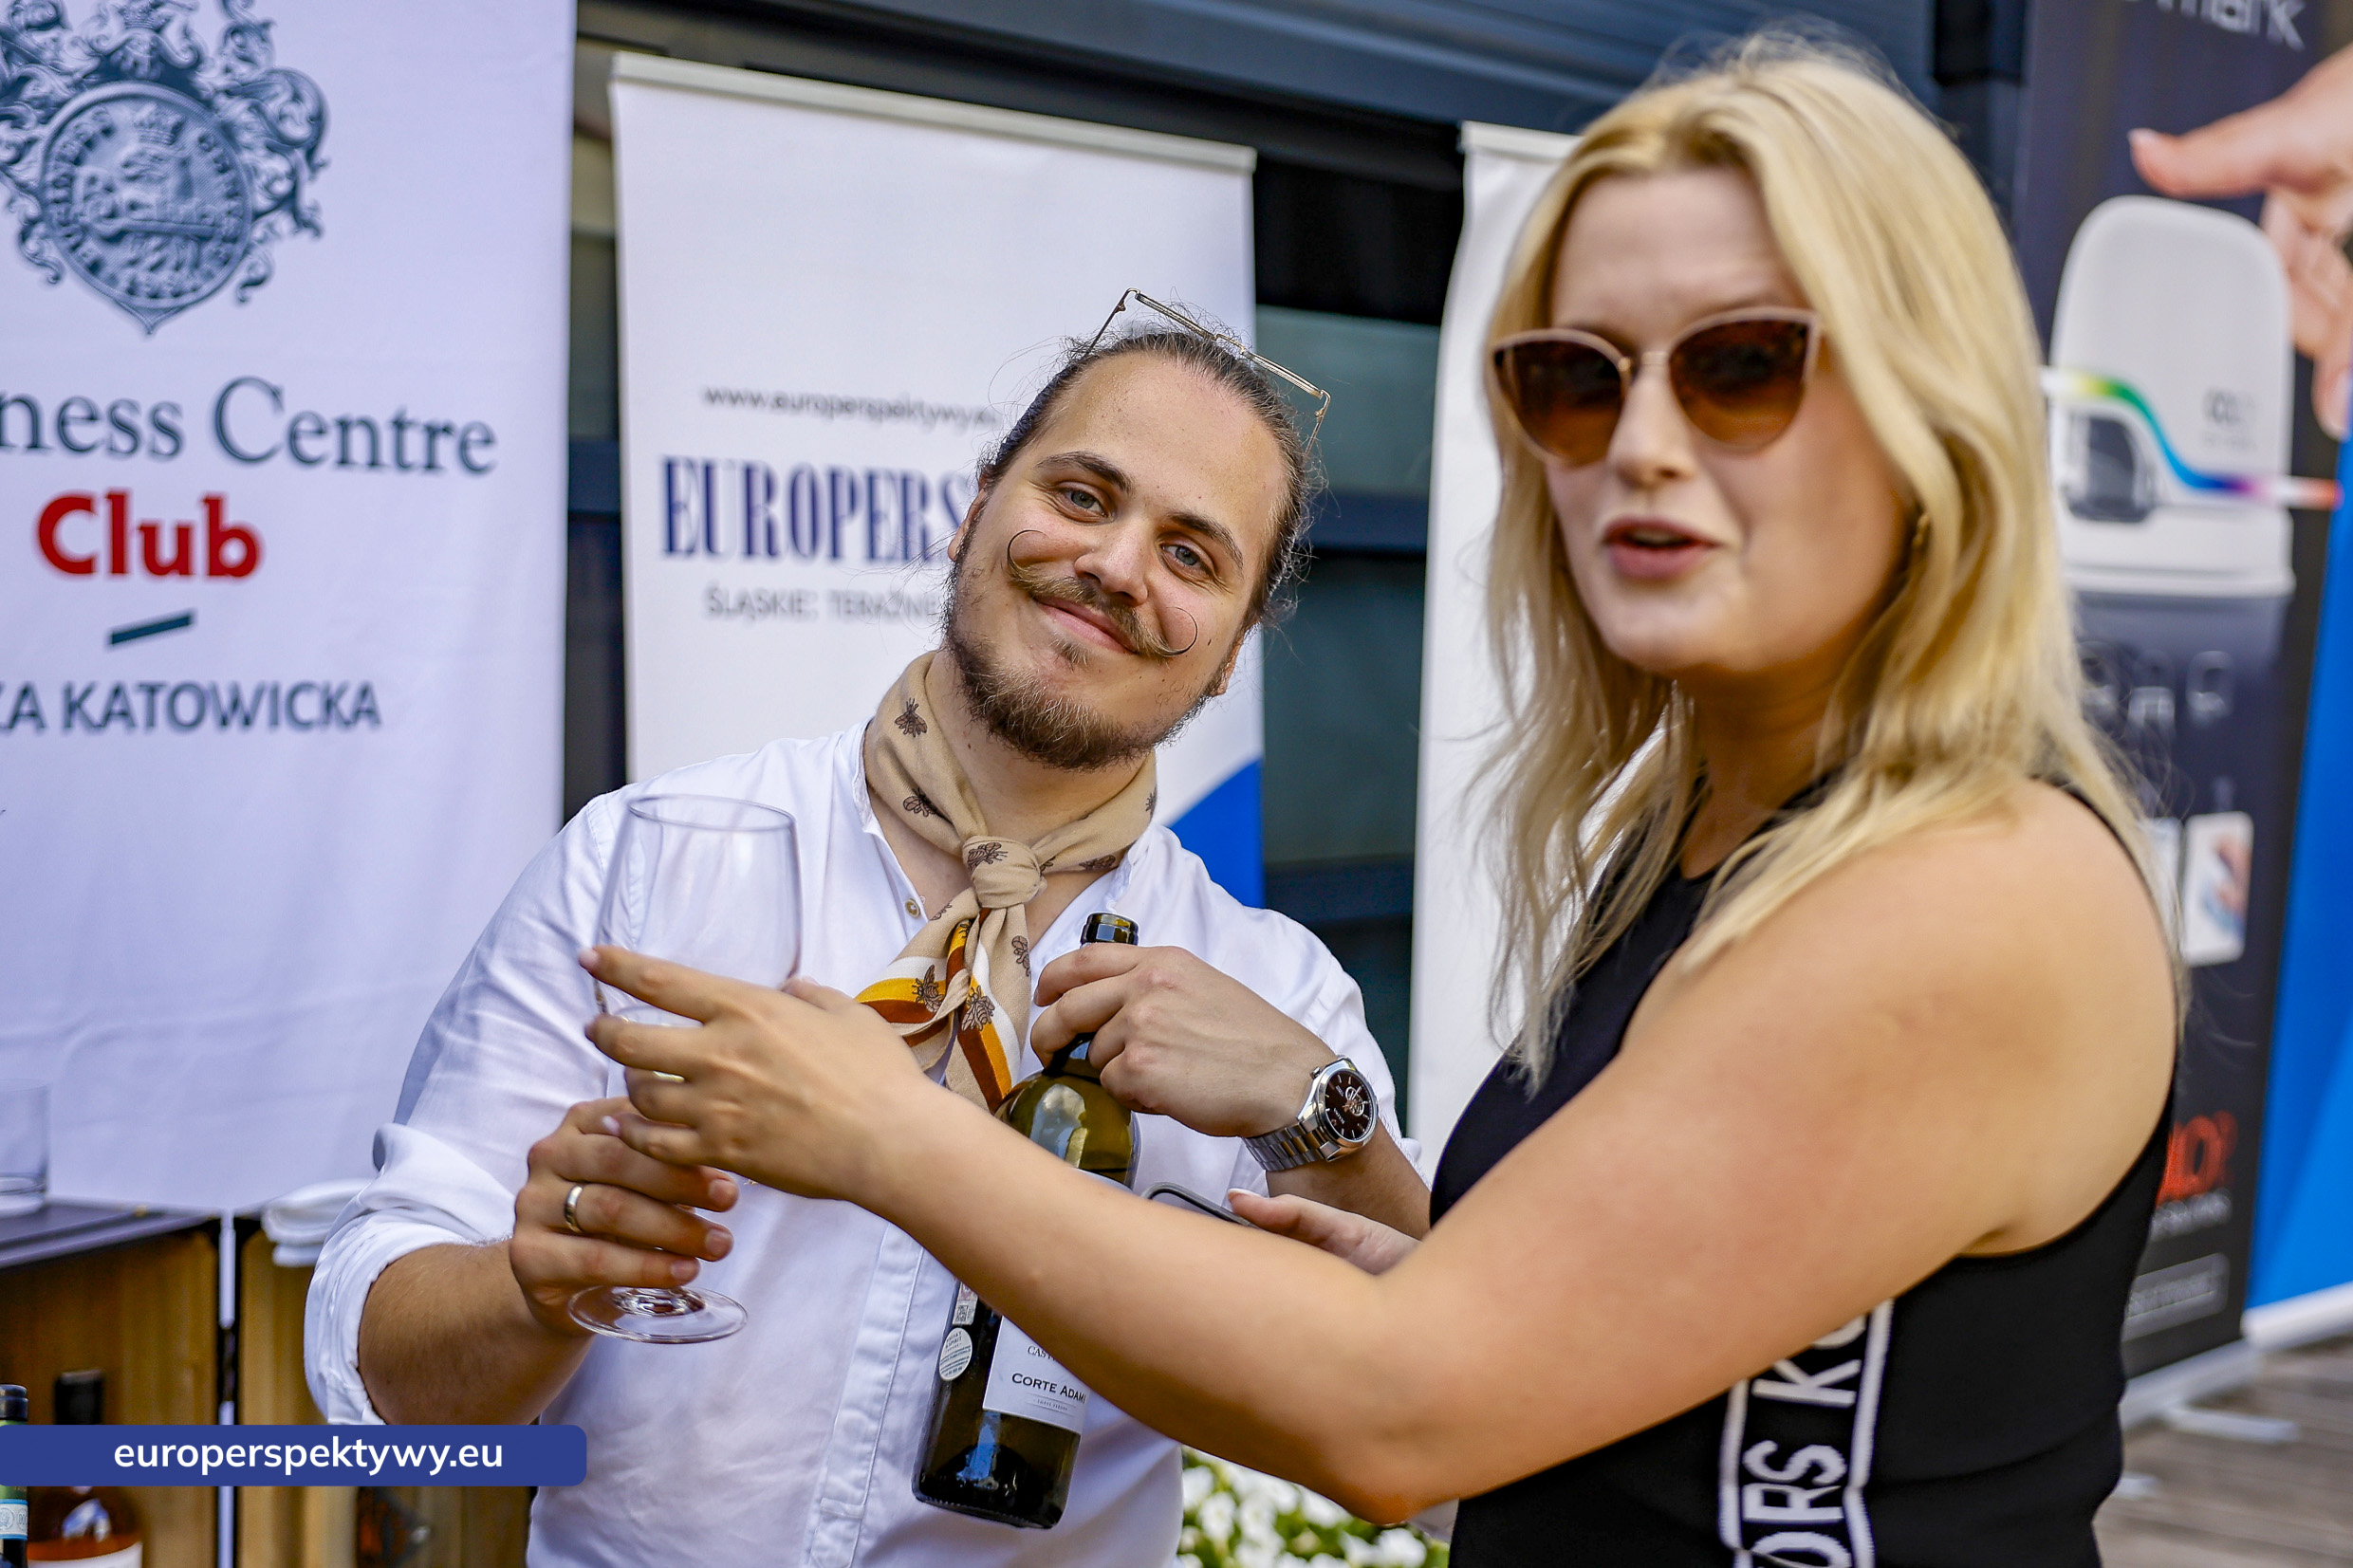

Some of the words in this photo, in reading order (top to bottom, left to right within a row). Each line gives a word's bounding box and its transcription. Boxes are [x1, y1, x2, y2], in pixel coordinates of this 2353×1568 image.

[211, 377, 495, 475] Centre
[36, 489, 262, 580] Club
[0, 681, 47, 735] A
[62, 681, 380, 734] KATOWICKA
[1011, 1373, 1058, 1393] CORTE
